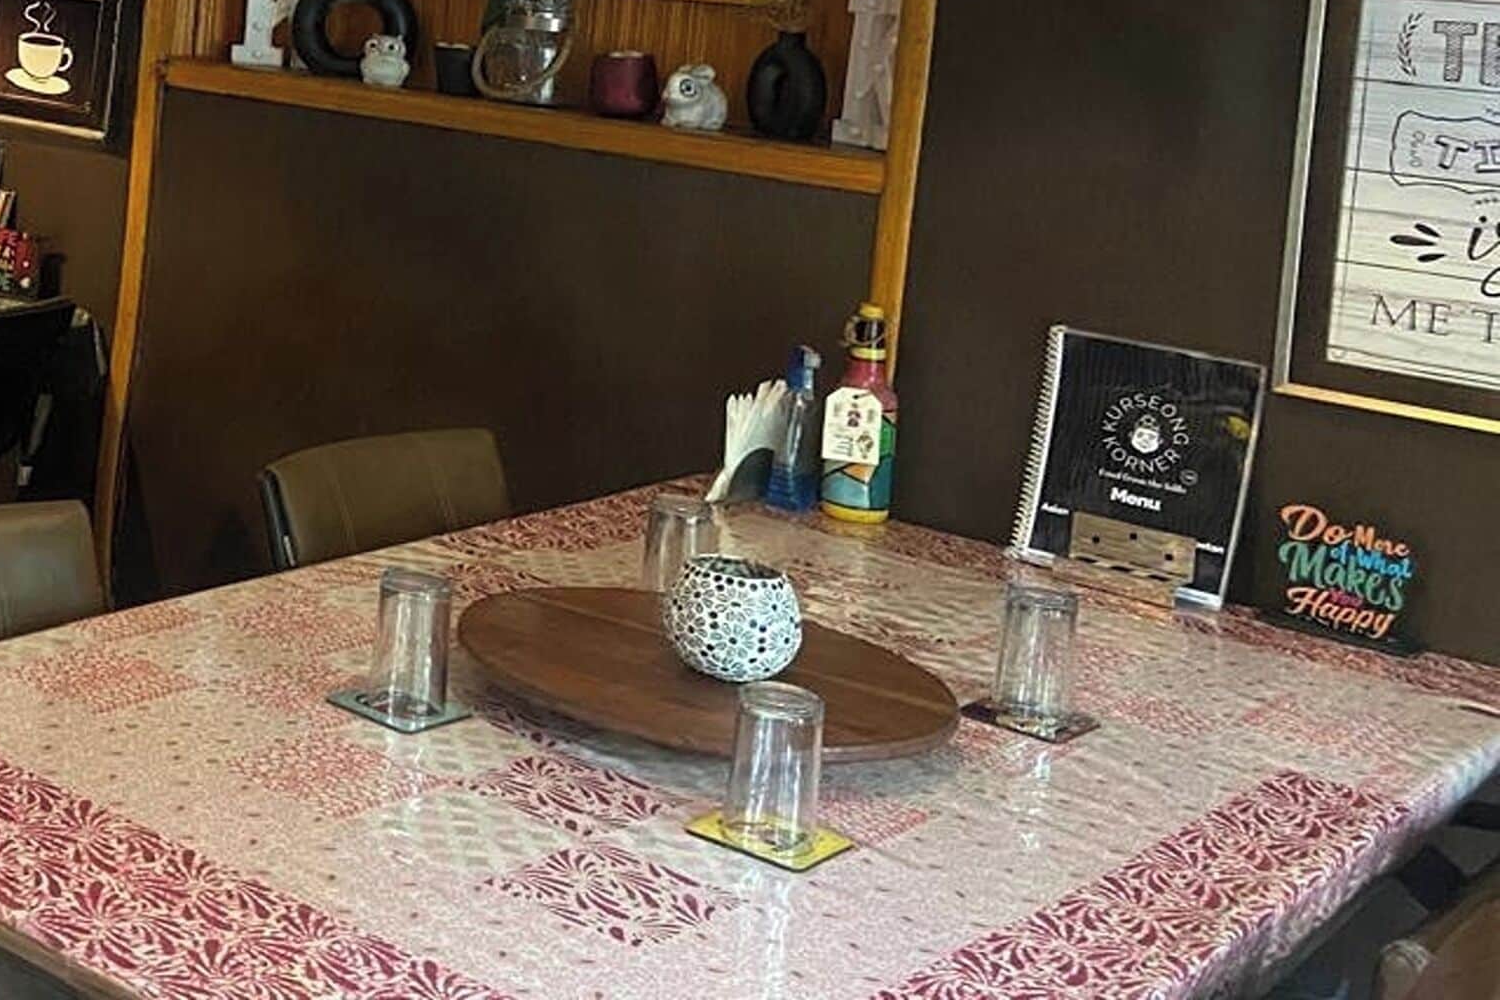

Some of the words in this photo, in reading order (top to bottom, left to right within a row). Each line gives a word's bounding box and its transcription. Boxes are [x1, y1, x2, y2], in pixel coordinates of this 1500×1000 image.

[1369, 294, 1452, 336] ME
[1102, 393, 1190, 445] KURSEONG
[1102, 436, 1181, 473] KORNER
[1109, 486, 1162, 511] Menu
[1280, 504, 1354, 546] Do
[1354, 524, 1410, 556] More
[1283, 586, 1396, 640] Happy
